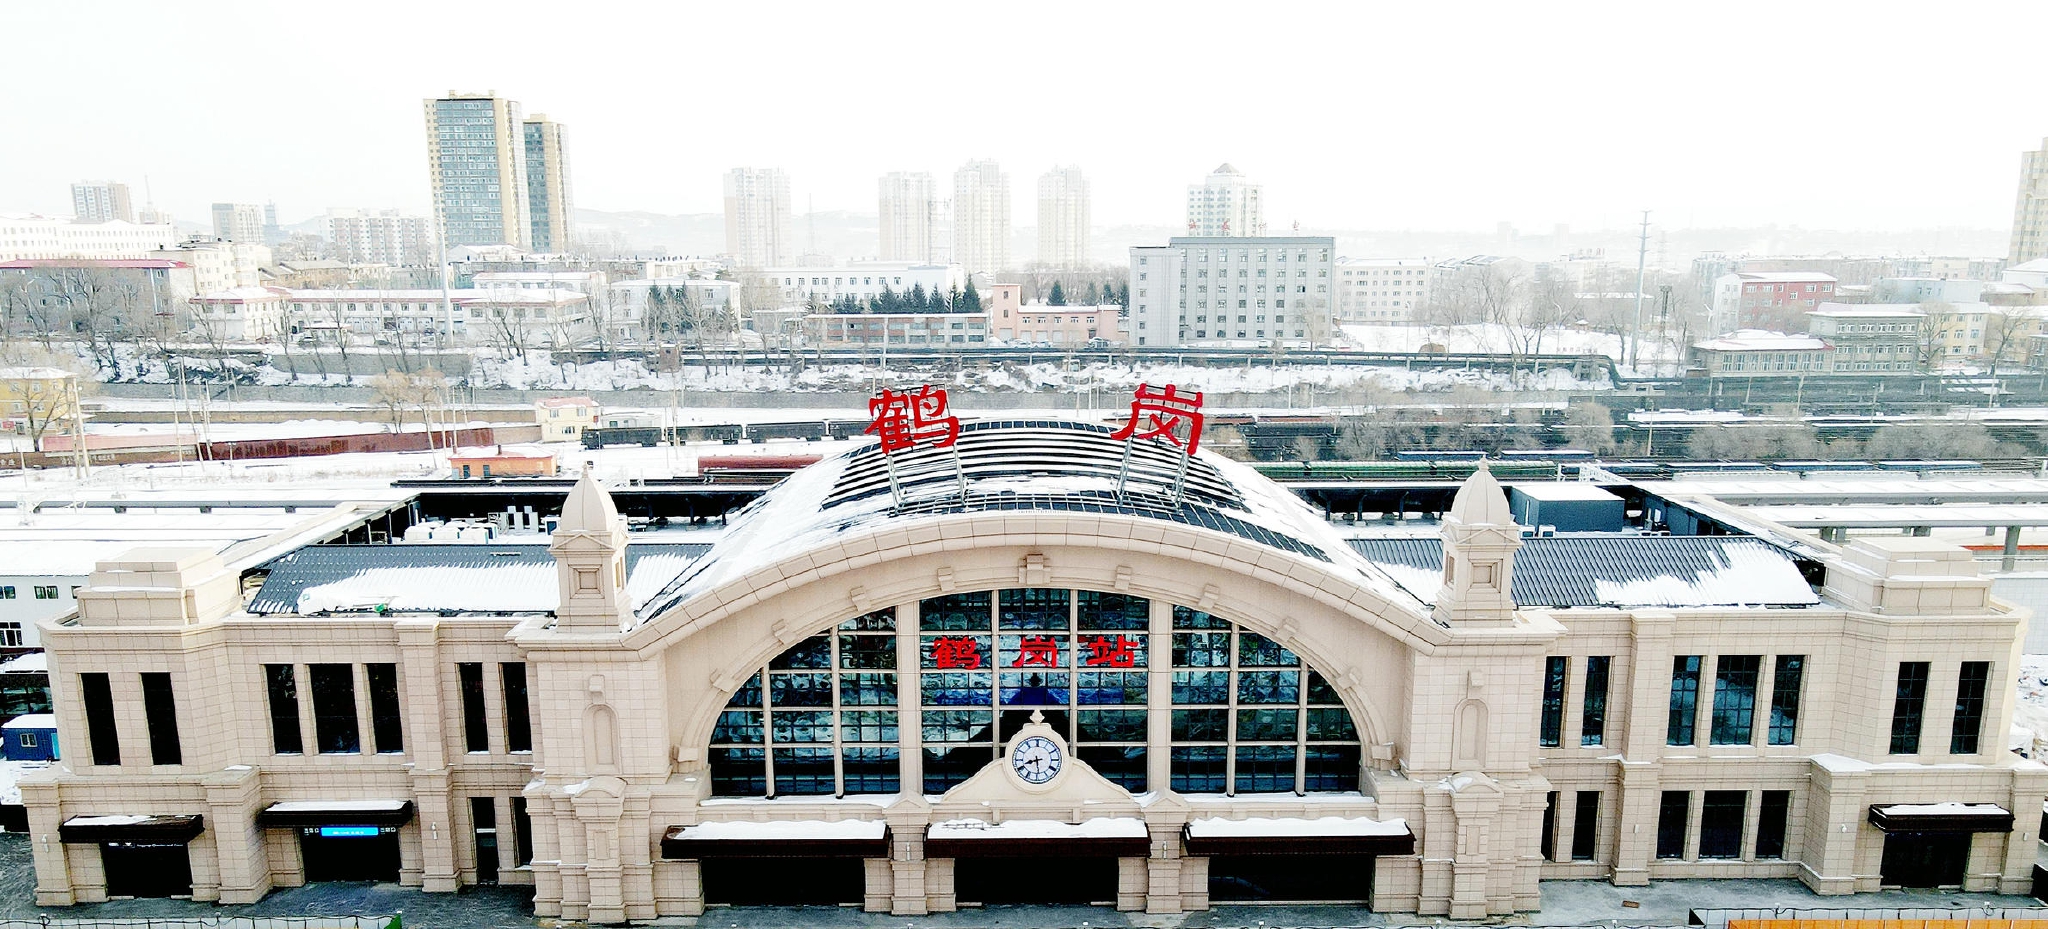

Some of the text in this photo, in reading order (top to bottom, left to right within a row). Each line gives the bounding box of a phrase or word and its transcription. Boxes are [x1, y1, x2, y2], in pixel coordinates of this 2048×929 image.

[864, 383, 1203, 455] 鹤岗
[930, 635, 1140, 670] 鹤岗站
